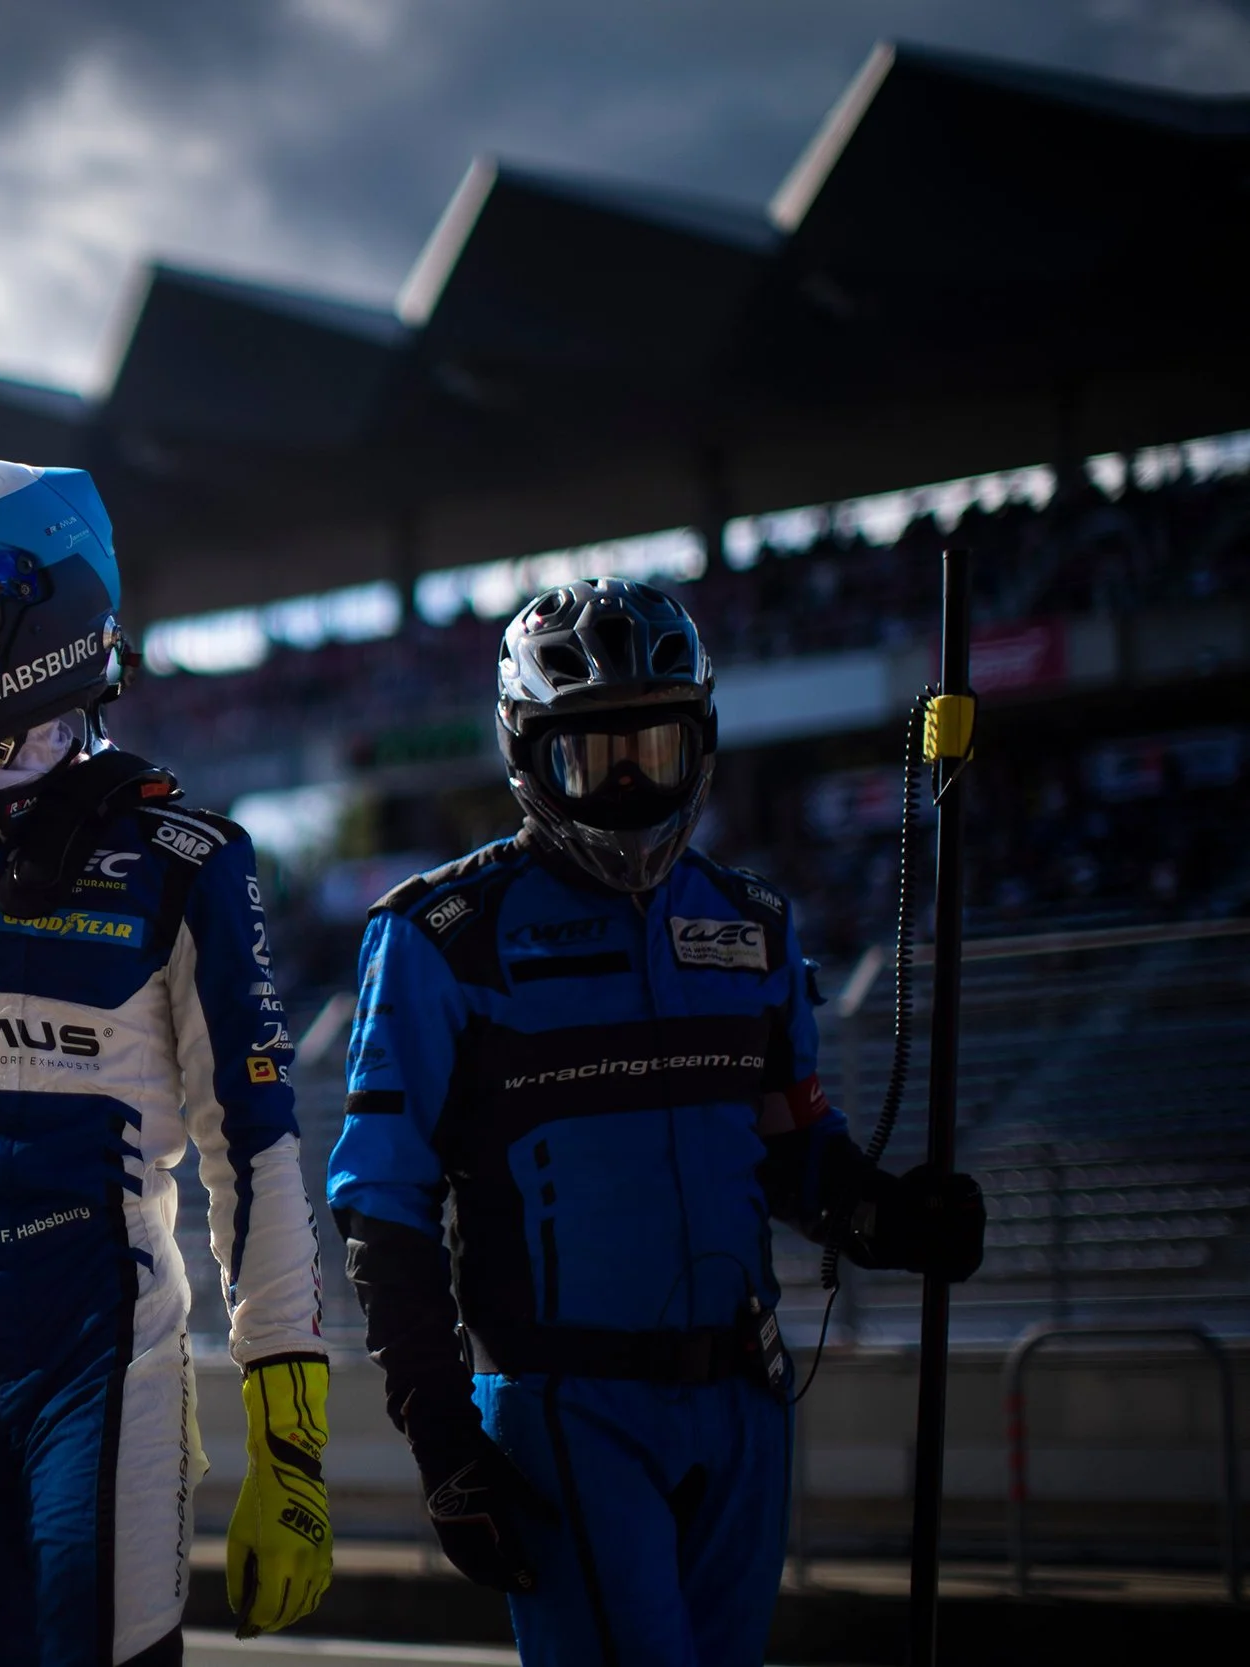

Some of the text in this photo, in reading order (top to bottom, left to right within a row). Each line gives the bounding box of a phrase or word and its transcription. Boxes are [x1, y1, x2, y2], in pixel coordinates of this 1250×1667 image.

[155, 825, 211, 859] OMP
[76, 879, 128, 892] DURANCE
[429, 898, 469, 931] OMP
[679, 924, 759, 945] WEC
[29, 1056, 101, 1071] EXHAUSTS
[0, 1206, 91, 1244] F. Habsburg
[281, 1506, 326, 1545] OMP
